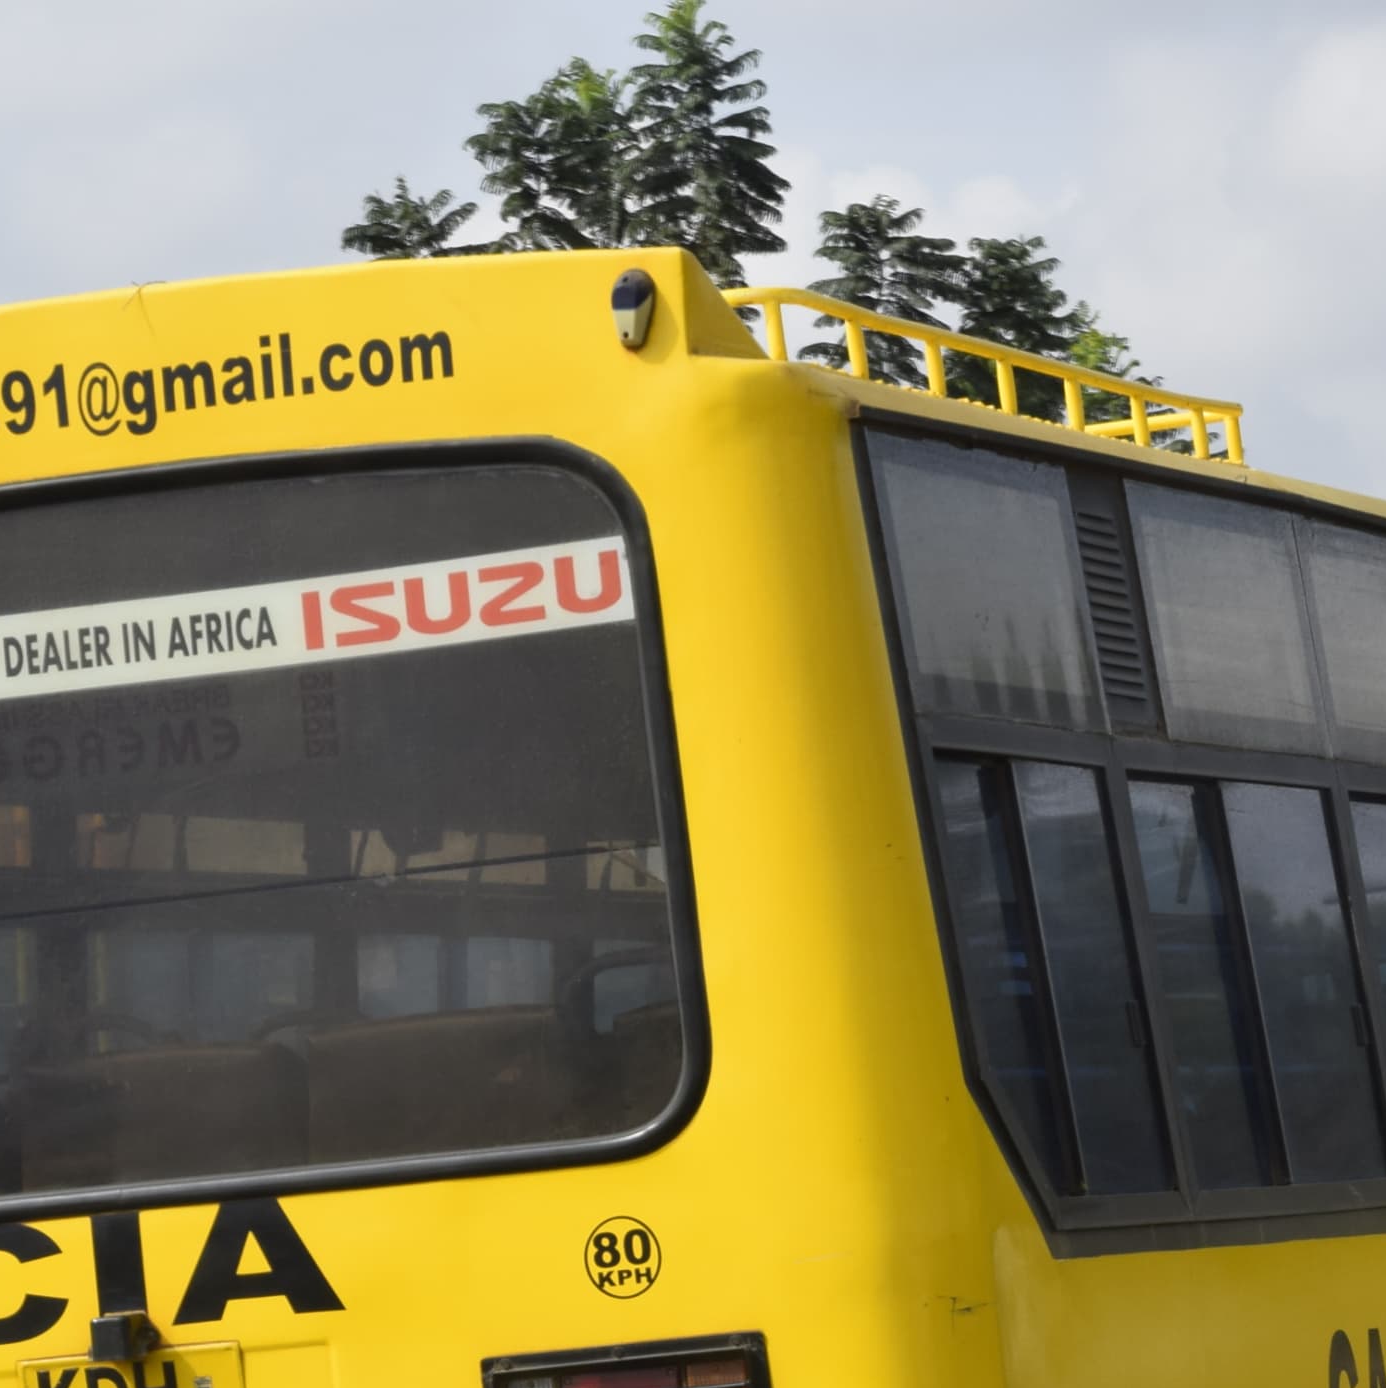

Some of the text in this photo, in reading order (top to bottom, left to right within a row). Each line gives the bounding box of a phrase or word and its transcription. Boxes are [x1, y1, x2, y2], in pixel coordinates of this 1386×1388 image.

[302, 550, 622, 650] ISUZU
[2, 625, 114, 678] DEALER
[121, 619, 157, 664] IN
[167, 606, 278, 659] AFRICA
[593, 1228, 651, 1268] 80
[598, 1267, 654, 1289] KPH
